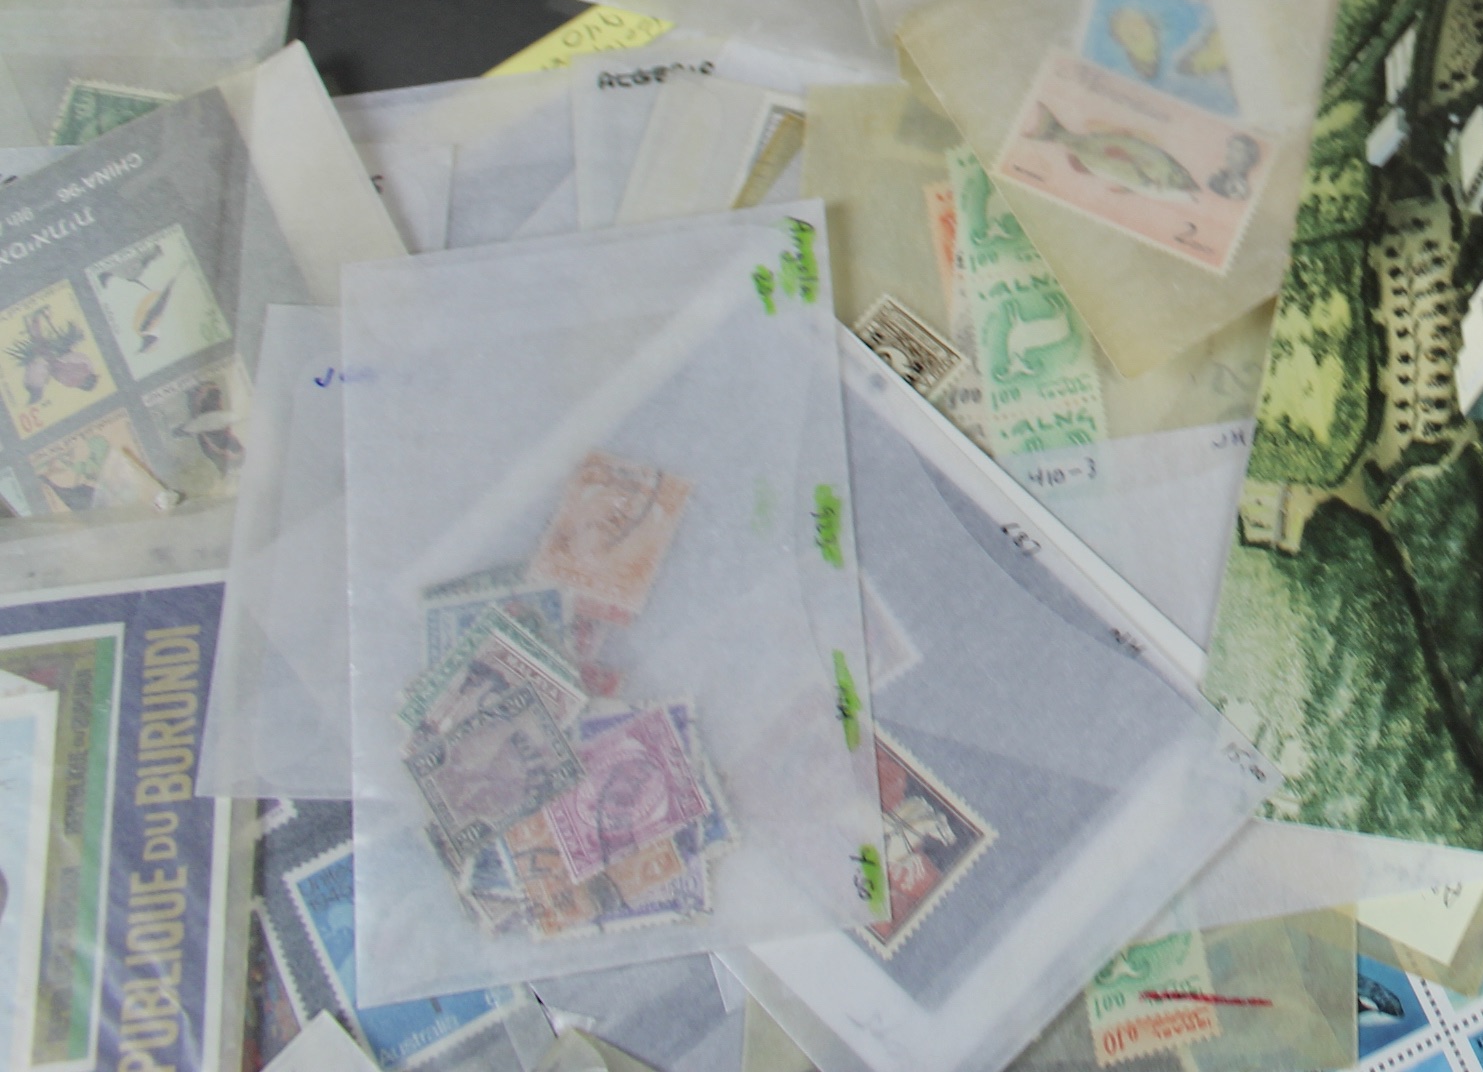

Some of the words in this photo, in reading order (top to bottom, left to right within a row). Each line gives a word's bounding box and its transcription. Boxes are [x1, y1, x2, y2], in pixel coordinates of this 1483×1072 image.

[82, 151, 144, 190] CHINA
[135, 624, 200, 805] BURUNDI
[144, 812, 178, 860] DU
[379, 1011, 462, 1069] Australia
